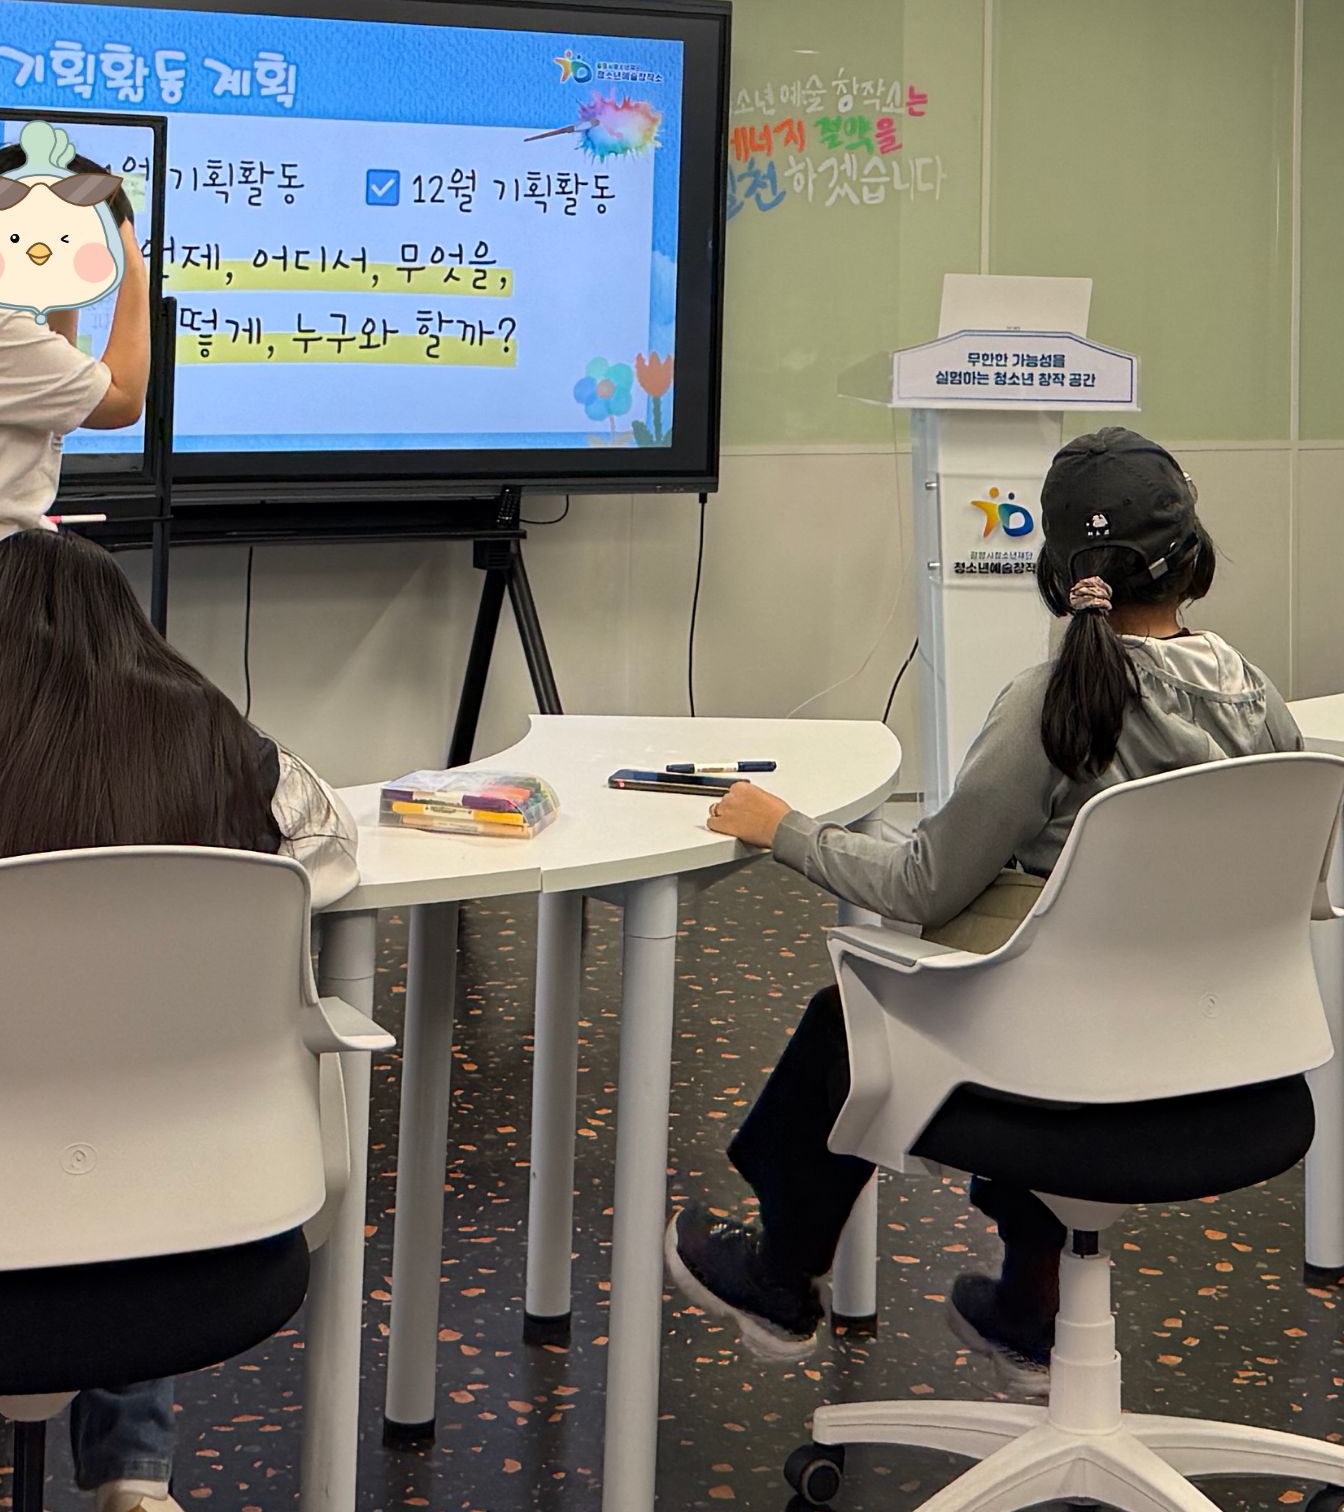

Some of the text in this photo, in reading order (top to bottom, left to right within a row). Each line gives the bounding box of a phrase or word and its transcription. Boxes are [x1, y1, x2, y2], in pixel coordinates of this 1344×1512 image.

[203, 51, 297, 109] 계획
[169, 159, 305, 207] 기획활동
[413, 168, 616, 216] 12월 기획활동
[252, 245, 379, 287] 어디서,
[396, 240, 507, 290] 무엇을,
[179, 308, 516, 359] 떻게, 누구와 할까?
[935, 370, 1096, 388] 실험하는 청소년 창작 공간
[967, 352, 1008, 368] 무한한
[954, 562, 1037, 574] 청소년예술창작
